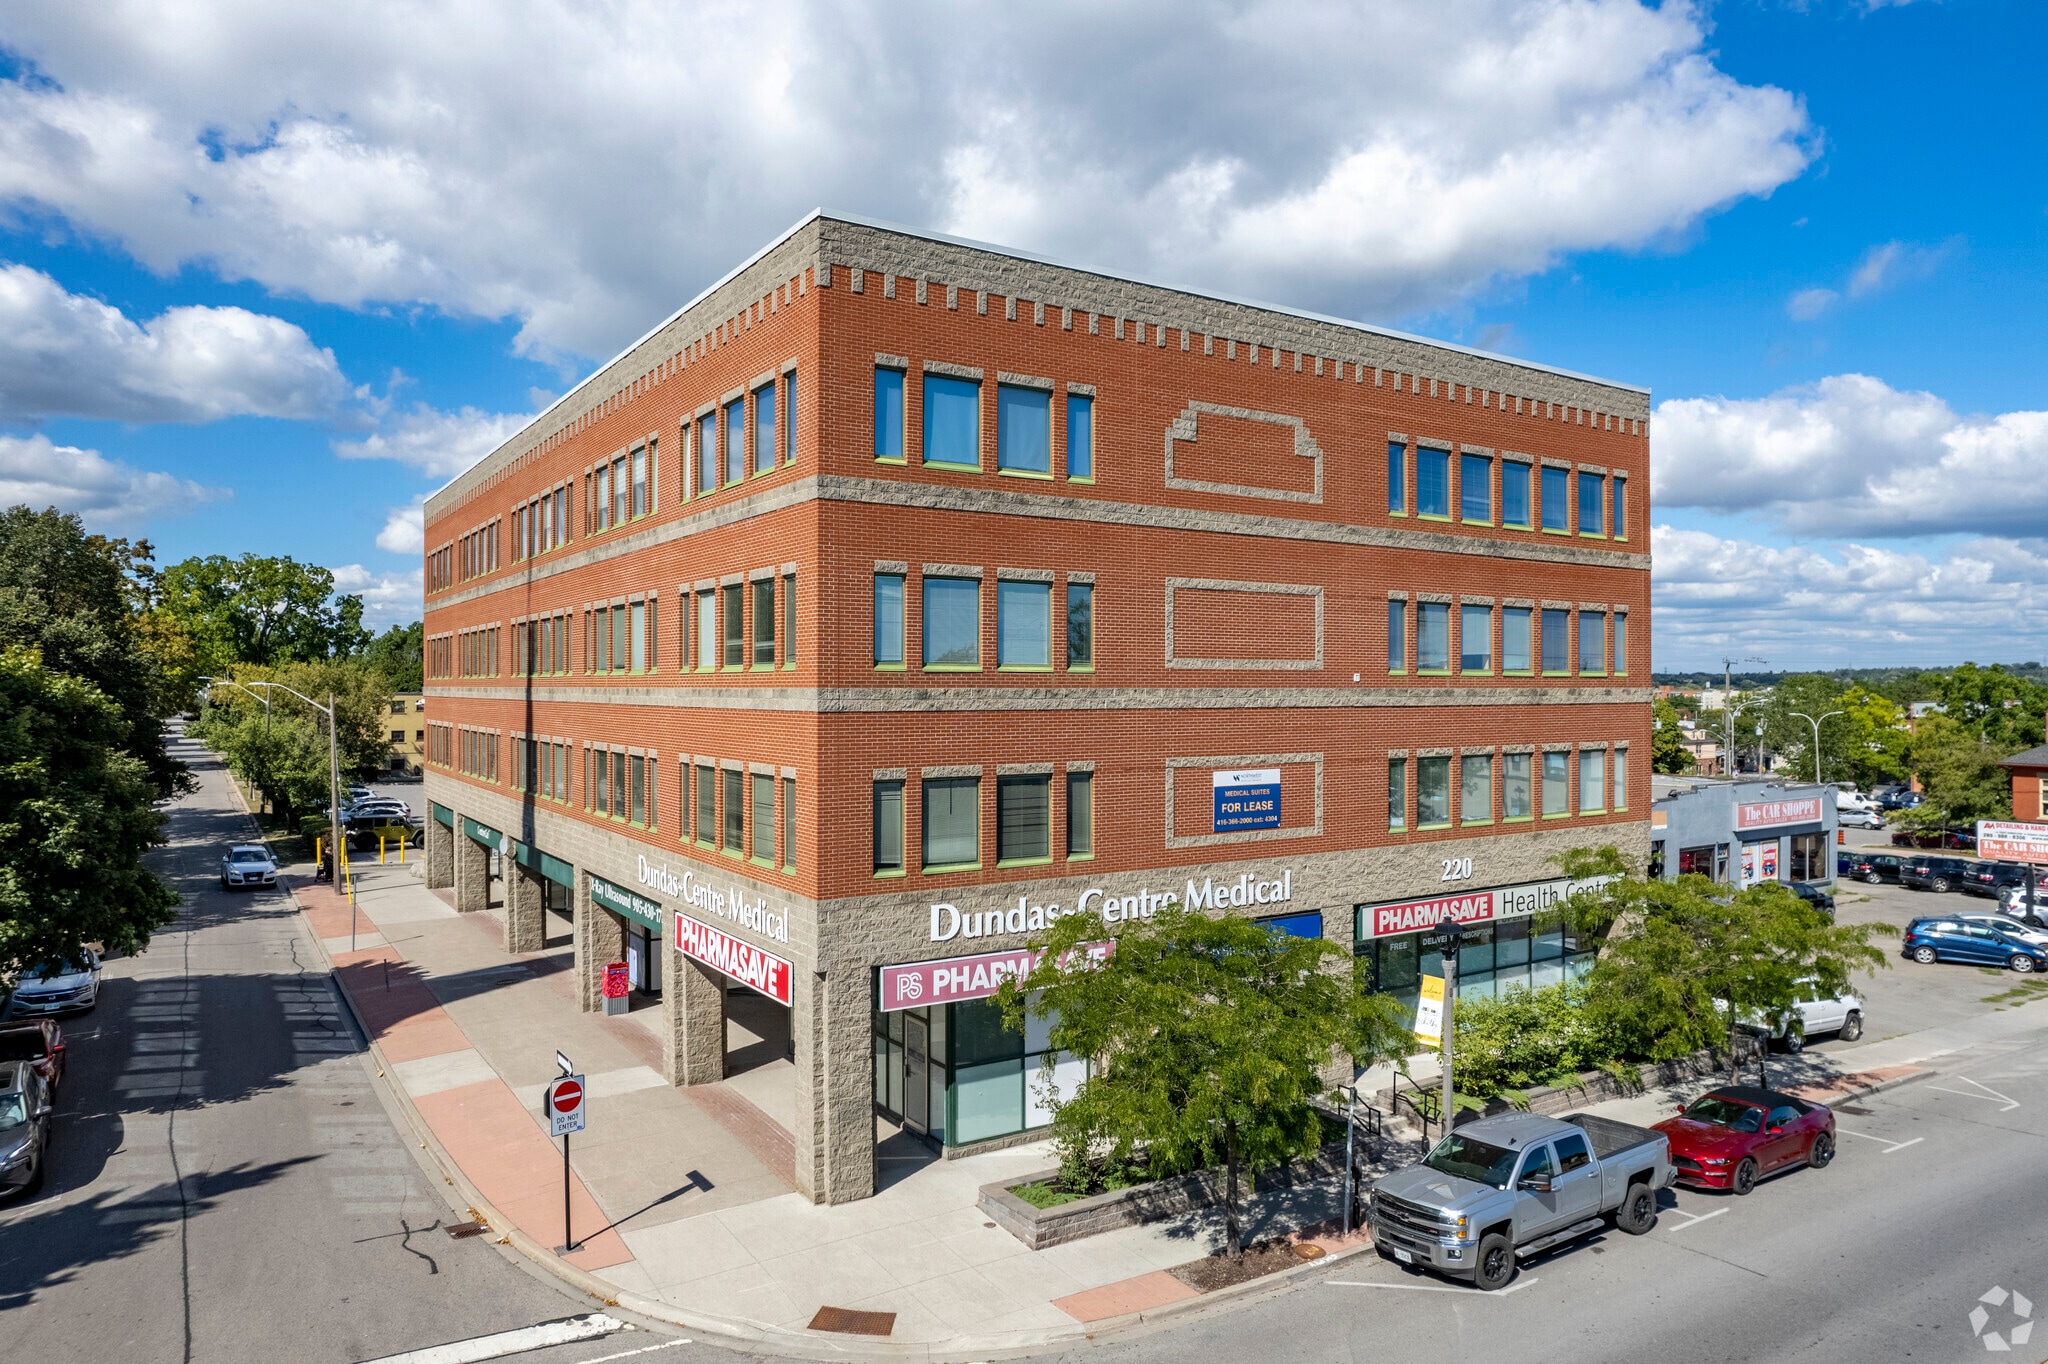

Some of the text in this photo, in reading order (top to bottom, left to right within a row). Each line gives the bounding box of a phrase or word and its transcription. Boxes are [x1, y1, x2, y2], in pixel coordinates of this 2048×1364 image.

[1221, 801, 1273, 813] FOR LEASE
[1745, 806, 1761, 821] The
[1762, 803, 1780, 819] CAR
[1782, 801, 1815, 816] SHOPPE
[1984, 841, 2002, 849] The
[2004, 842, 2027, 852] CAR
[1442, 858, 1472, 880] 220
[605, 883, 631, 908] Ultrasound
[1184, 869, 1291, 913] Medical
[728, 888, 789, 943] Medical
[1379, 880, 1609, 932] PHARMASAVE Health Centr
[1390, 928, 1494, 951] FREE DELIVEY RESCRIPTIONS
[681, 918, 778, 996] PHARMASAVE
[556, 1112, 579, 1124] DO NOT
[558, 1121, 578, 1131] ENTER
